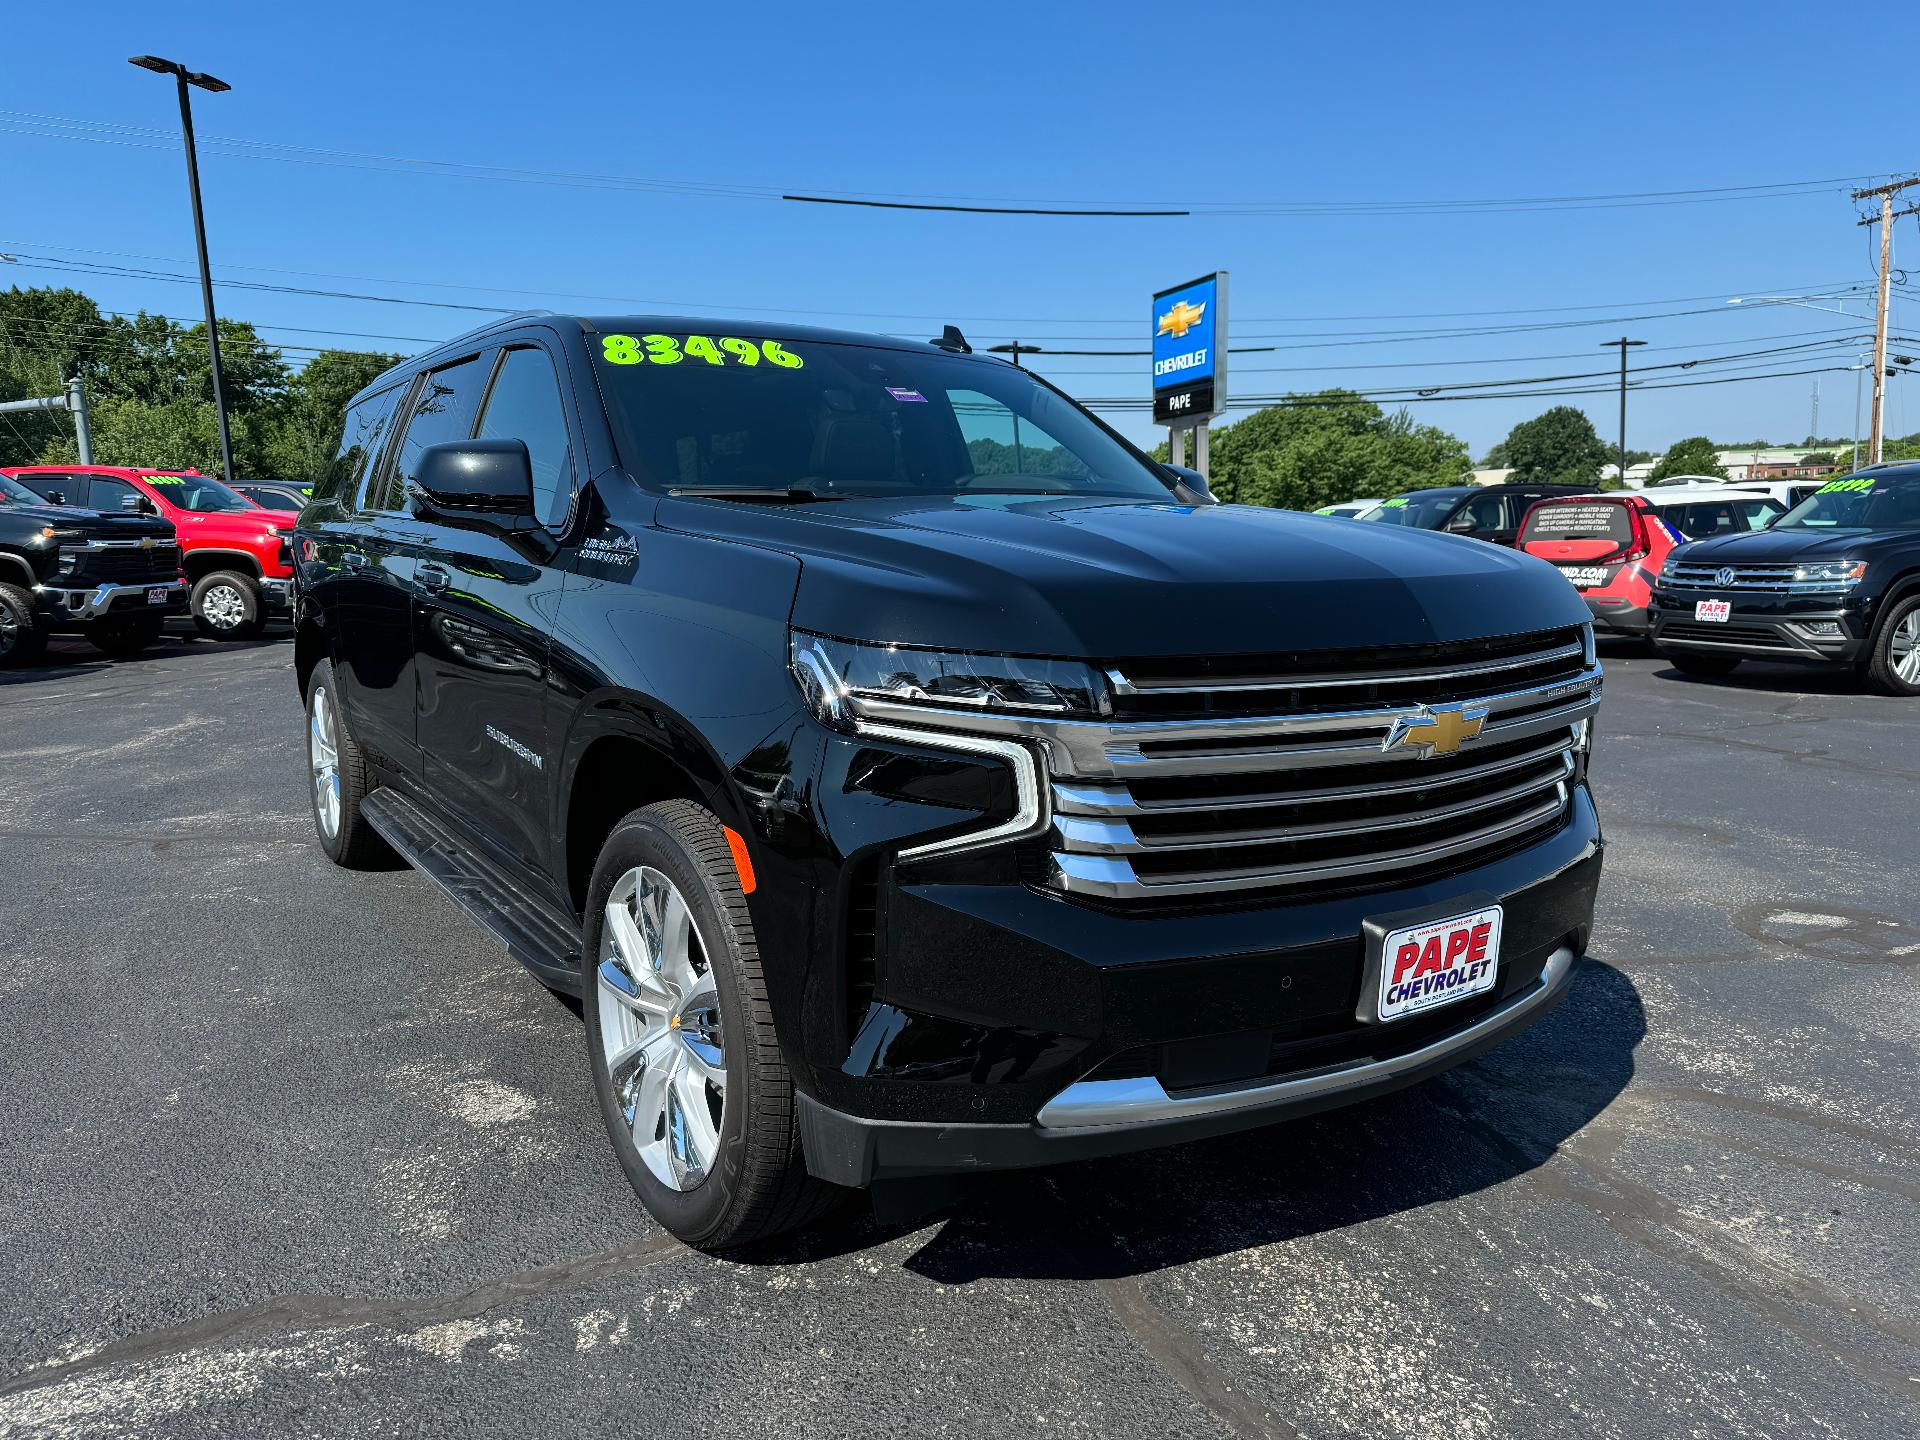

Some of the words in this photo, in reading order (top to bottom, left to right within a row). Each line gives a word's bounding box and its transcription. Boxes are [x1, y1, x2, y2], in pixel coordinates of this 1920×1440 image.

[602, 335, 804, 369] 83496
[1155, 348, 1208, 376] CHEVROLET
[1169, 393, 1191, 411] PAPE
[1699, 603, 1728, 613] PAPE
[1547, 686, 1566, 698] HIGH
[486, 724, 542, 770] SUBURBAN
[1391, 921, 1493, 986] PAPE
[1386, 958, 1492, 1006] CHEVROLET
